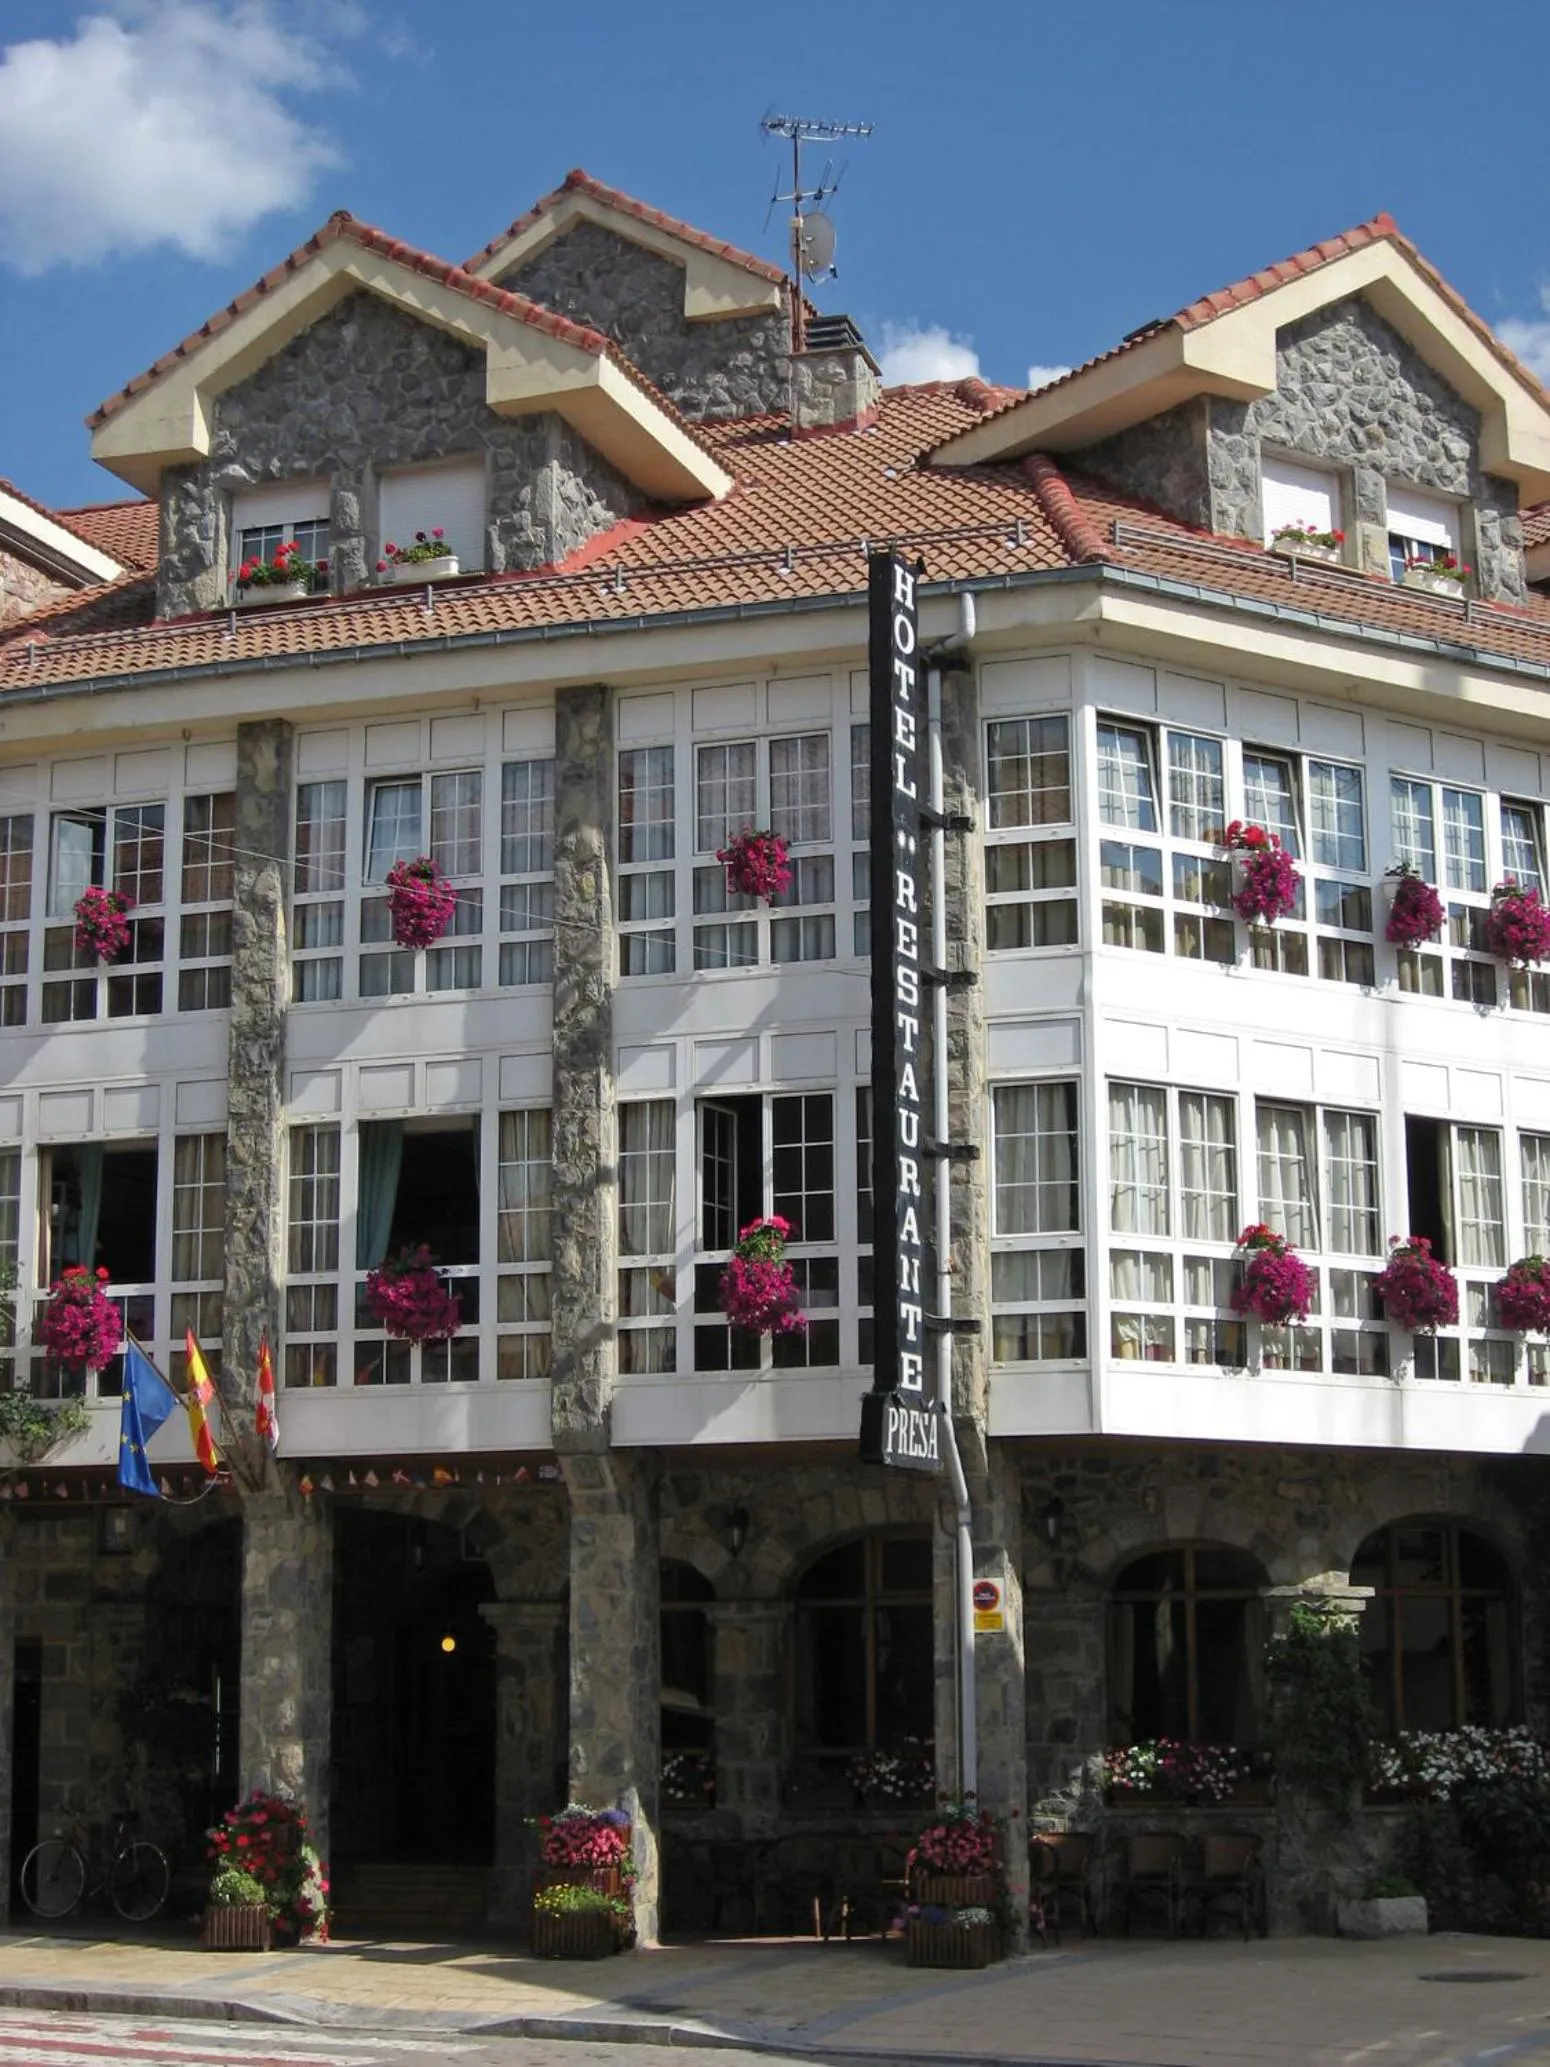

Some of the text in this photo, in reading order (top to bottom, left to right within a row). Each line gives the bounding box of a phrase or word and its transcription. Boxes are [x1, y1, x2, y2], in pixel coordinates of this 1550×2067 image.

[893, 564, 922, 1391] HOTEL RESTAURANTE
[886, 1407, 938, 1459] PRESA
